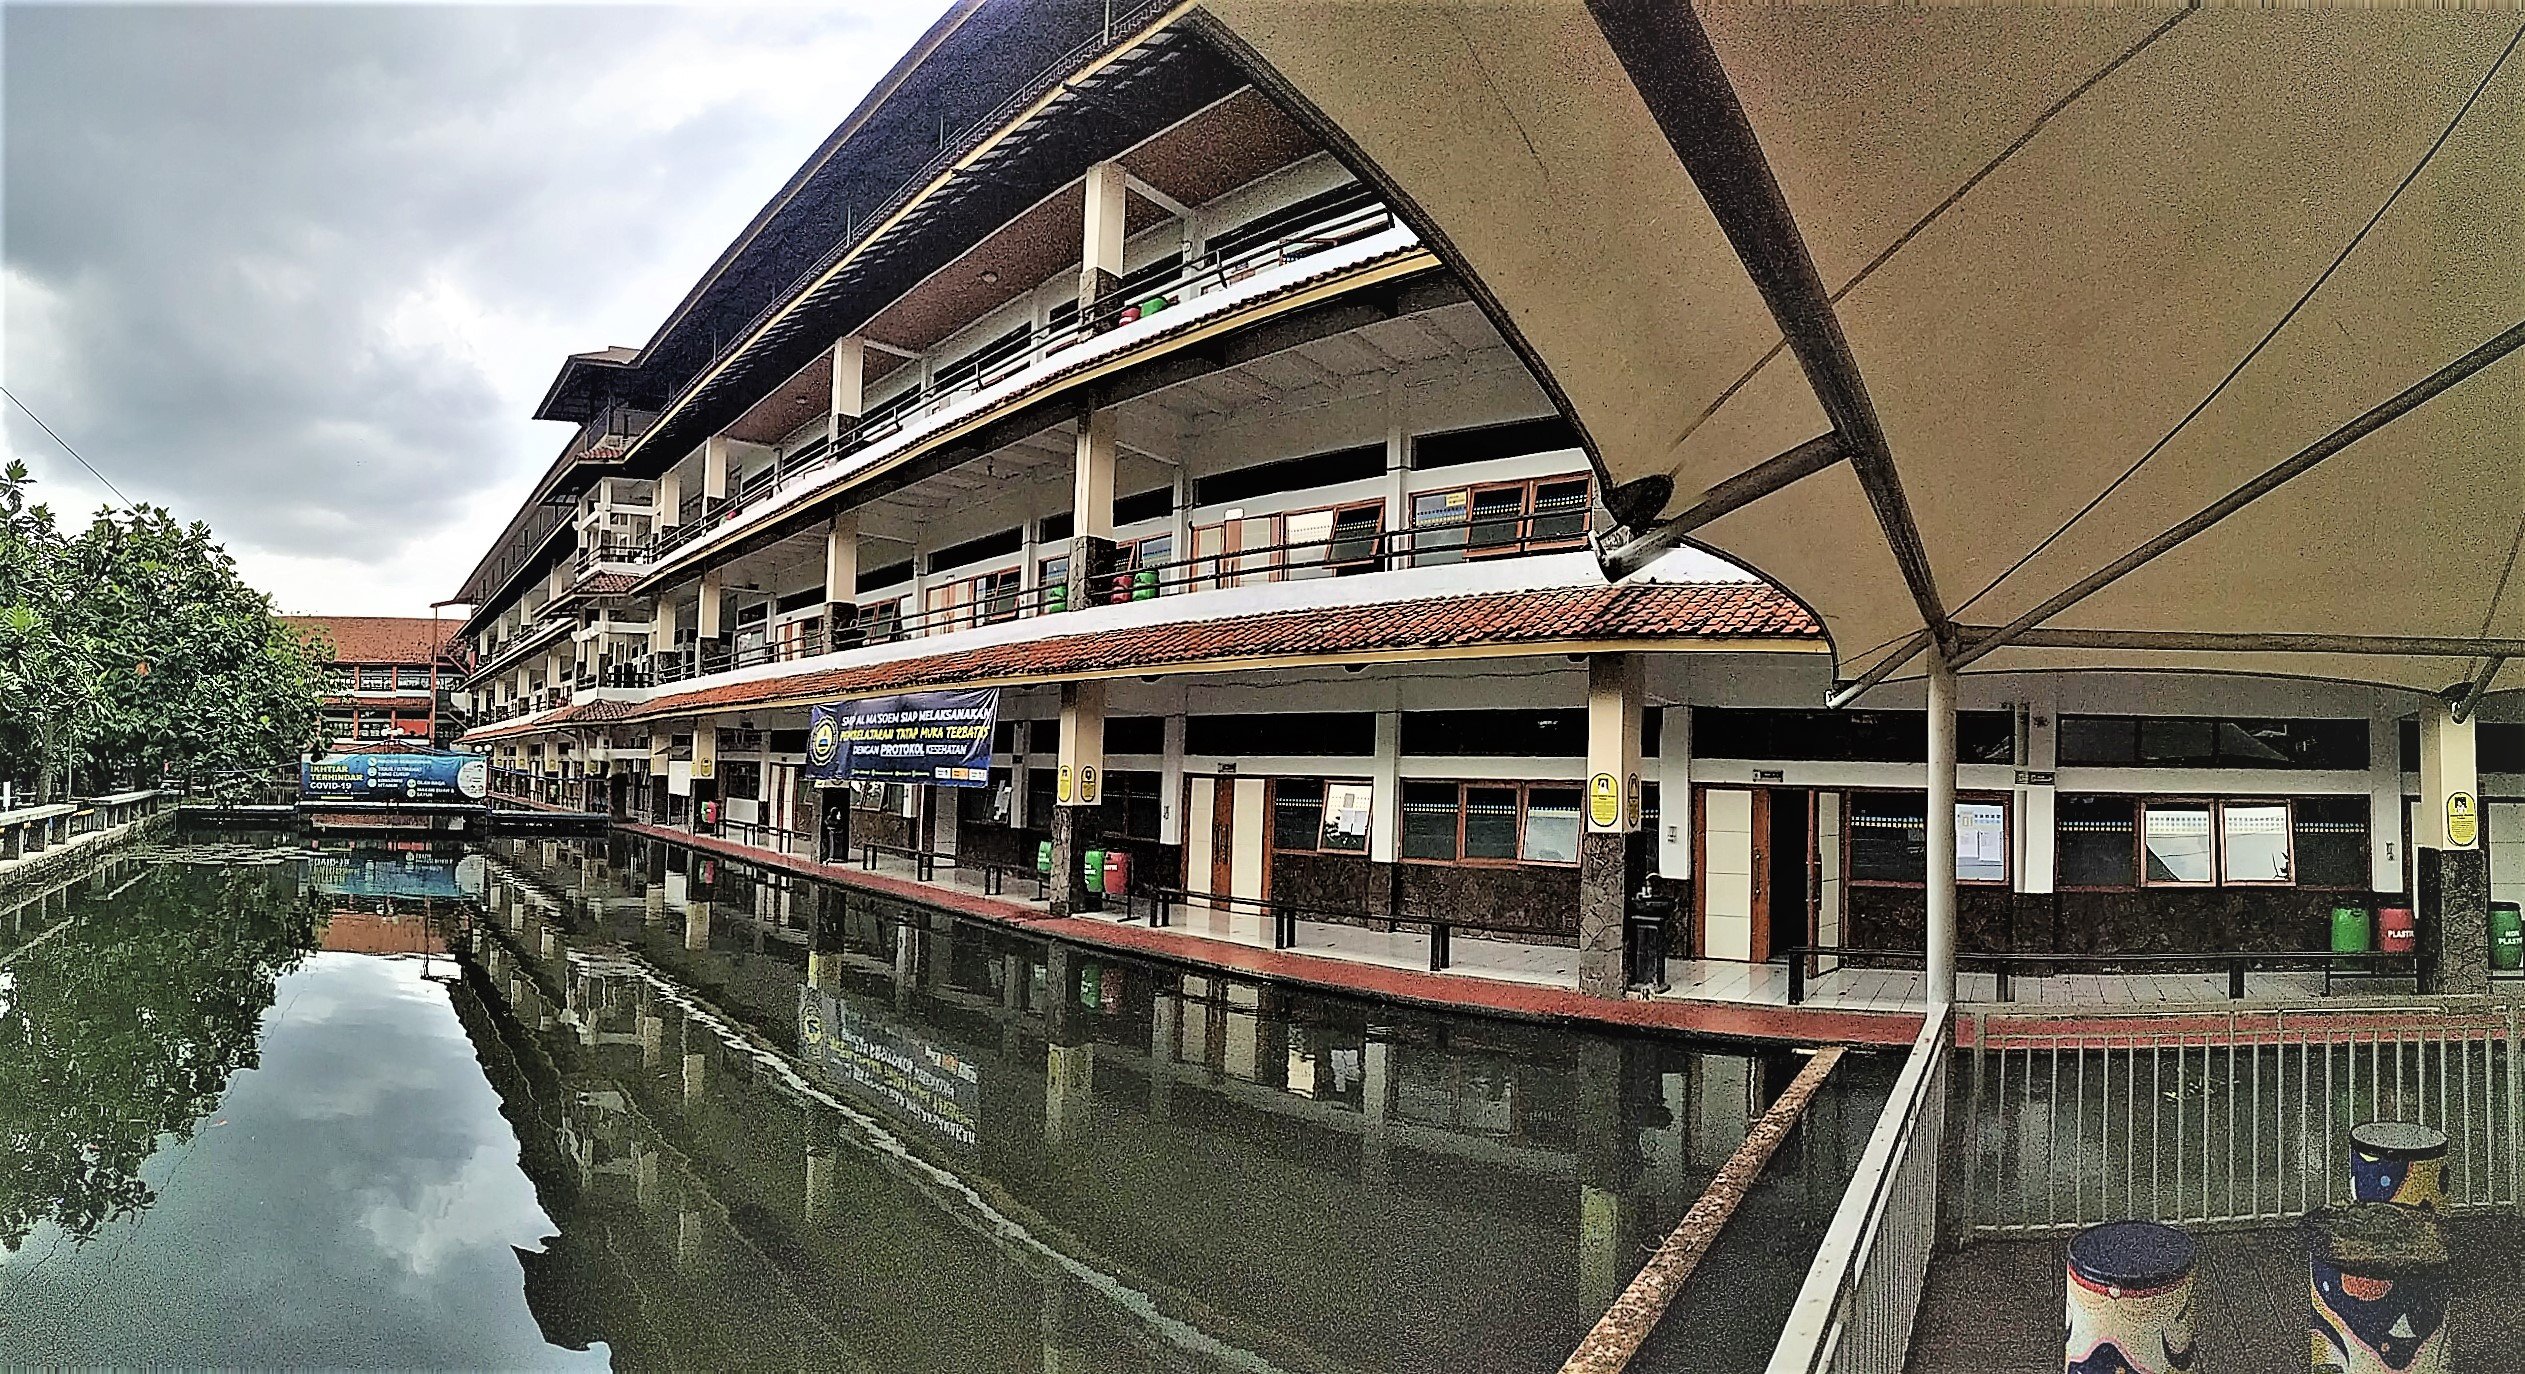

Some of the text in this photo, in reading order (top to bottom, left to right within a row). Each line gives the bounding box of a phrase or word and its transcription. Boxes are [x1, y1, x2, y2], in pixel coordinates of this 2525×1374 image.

[900, 711, 918, 723] SIAP
[919, 708, 991, 721] MELAKSANAKAN
[896, 727, 918, 740] TATAP
[920, 726, 944, 739] MUKA
[946, 725, 990, 739] TERBATAS
[852, 743, 968, 756] DENGAN PROTOKOL KESEHATAN
[310, 765, 349, 773] IKHTIAR
[310, 773, 364, 781] TERHINDAR
